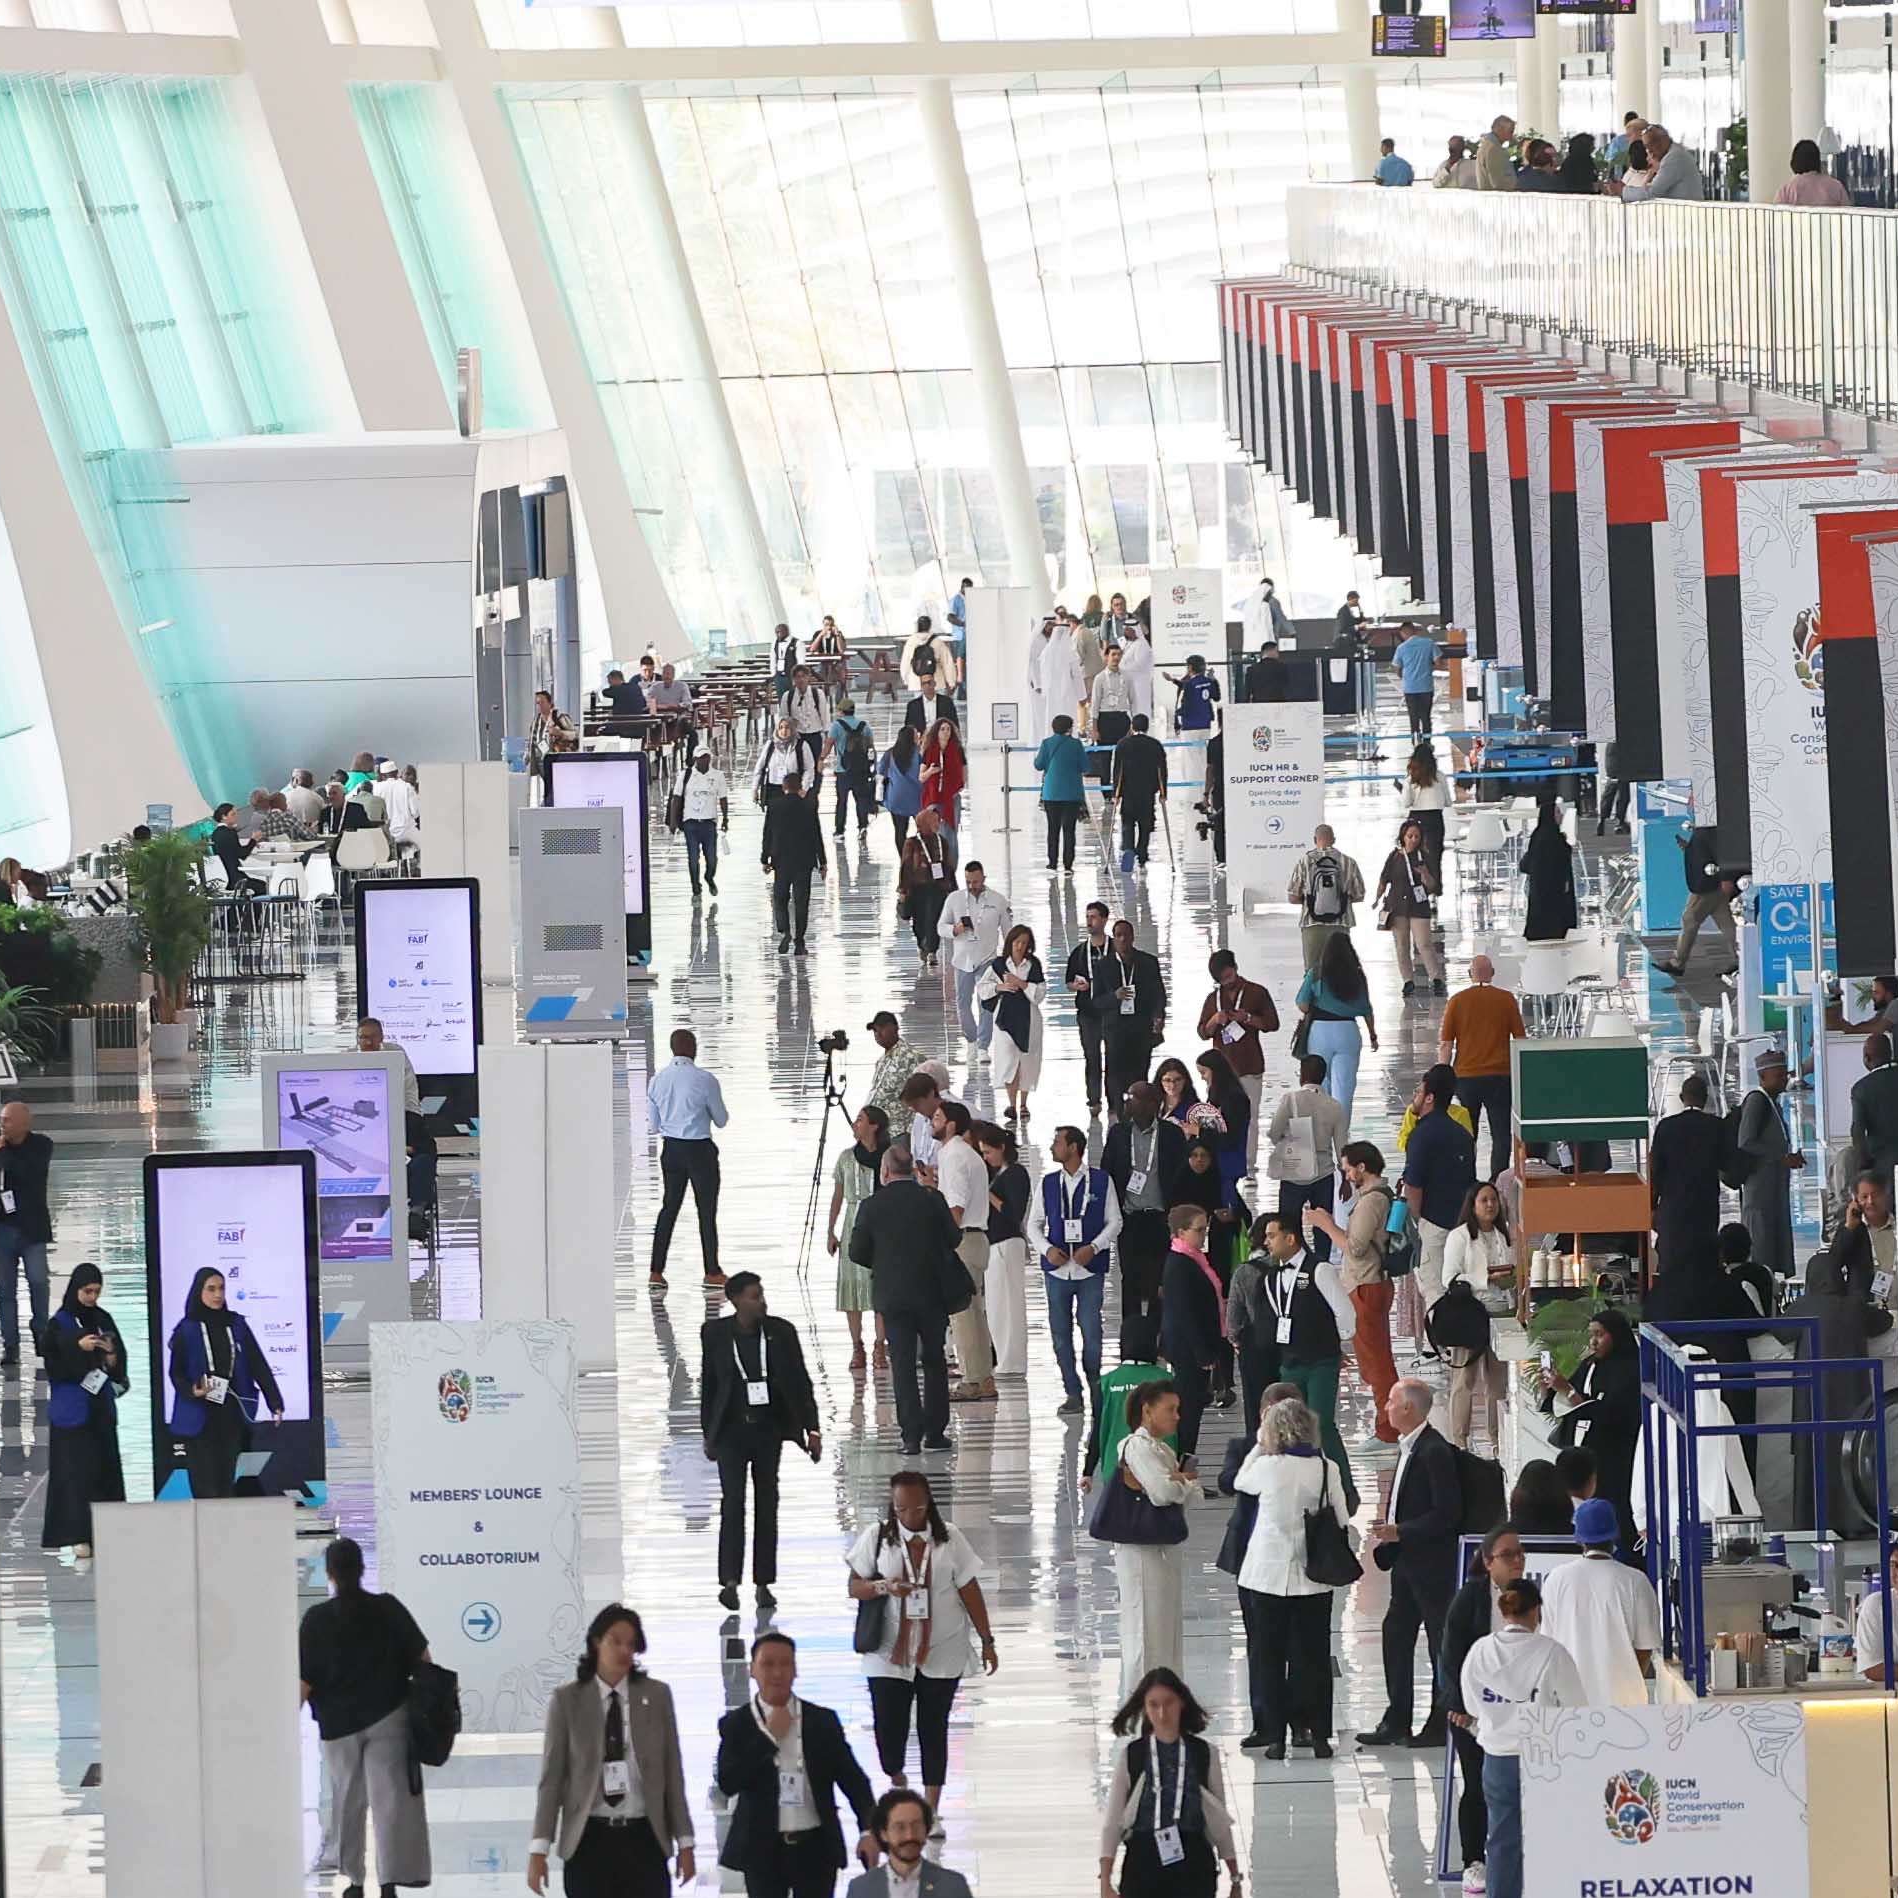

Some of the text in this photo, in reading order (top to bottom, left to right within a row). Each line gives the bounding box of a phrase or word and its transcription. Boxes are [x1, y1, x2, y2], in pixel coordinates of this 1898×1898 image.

[1811, 706, 1826, 718] IU
[1770, 887, 1804, 898] SAVE
[1771, 935, 1812, 945] ENVIRO
[218, 1231, 239, 1241] FAB
[410, 1488, 542, 1502] MEMBERS' LOUNGE
[473, 1521, 484, 1533] &
[419, 1552, 540, 1566] COLLABOTORIUM
[1666, 1779, 1696, 1789] IUCN
[1666, 1790, 1700, 1800] World
[1667, 1800, 1745, 1812] Conservation
[1667, 1812, 1721, 1825] Congress
[1580, 1875, 1753, 1898] RELAXATION
